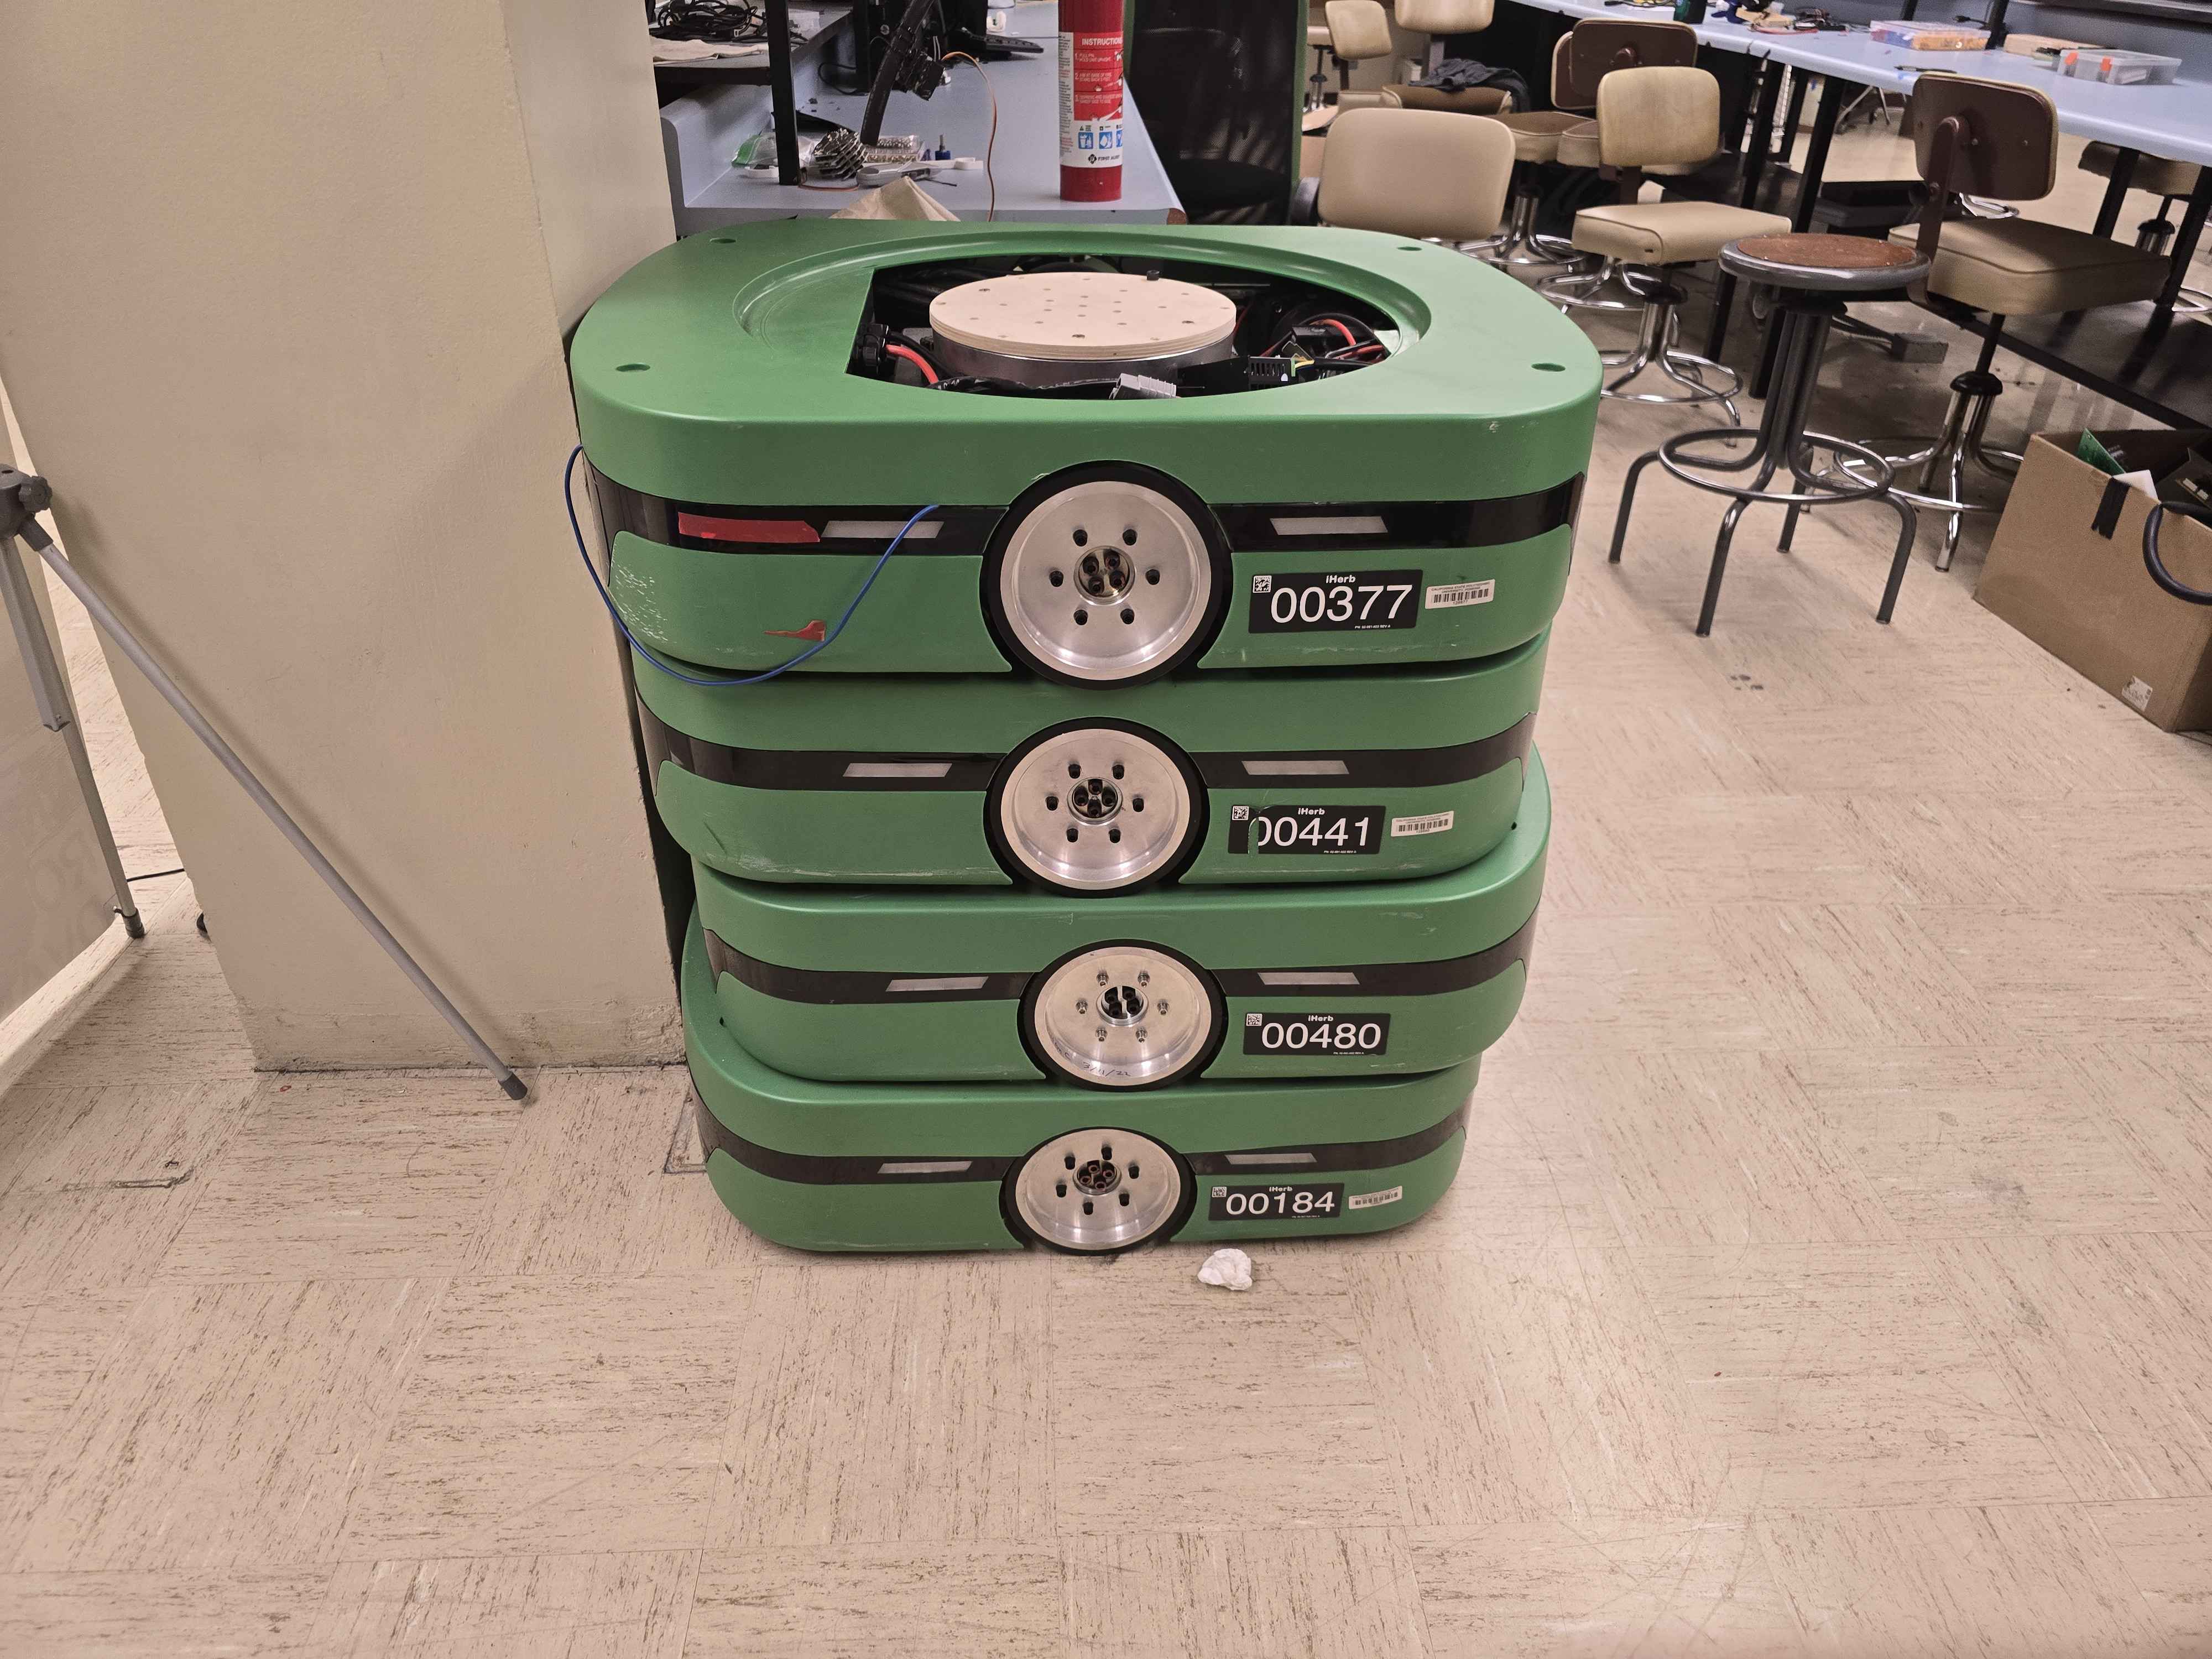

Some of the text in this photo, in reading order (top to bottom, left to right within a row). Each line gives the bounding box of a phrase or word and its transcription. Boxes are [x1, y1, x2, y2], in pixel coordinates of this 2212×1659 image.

[1082, 37, 1123, 45] INSTRUCTION
[1326, 575, 1356, 583] iHerb
[1271, 584, 1412, 623] 00377
[1262, 1022, 1381, 1049] 00480
[1226, 1191, 1335, 1215] 00184
